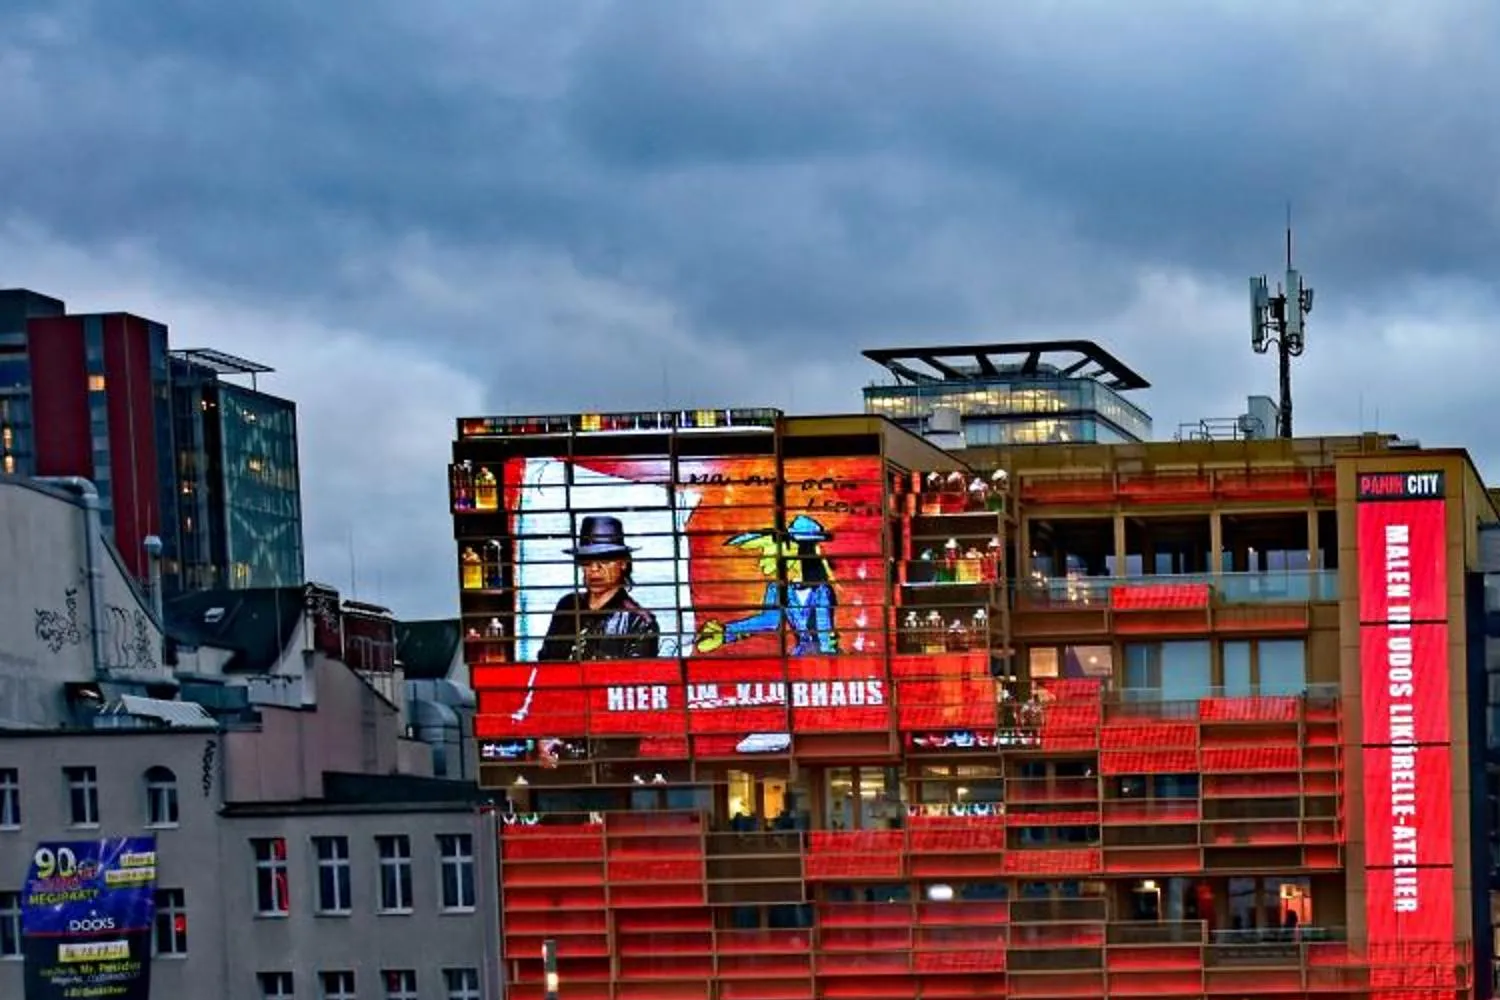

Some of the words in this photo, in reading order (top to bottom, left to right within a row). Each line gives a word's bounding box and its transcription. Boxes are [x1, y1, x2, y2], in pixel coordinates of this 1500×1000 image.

[1407, 473, 1439, 495] CITY
[1385, 525, 1411, 598] MALEN
[1388, 637, 1414, 697] UDOS
[607, 685, 669, 711] HIER
[69, 918, 115, 932] DOCKS
